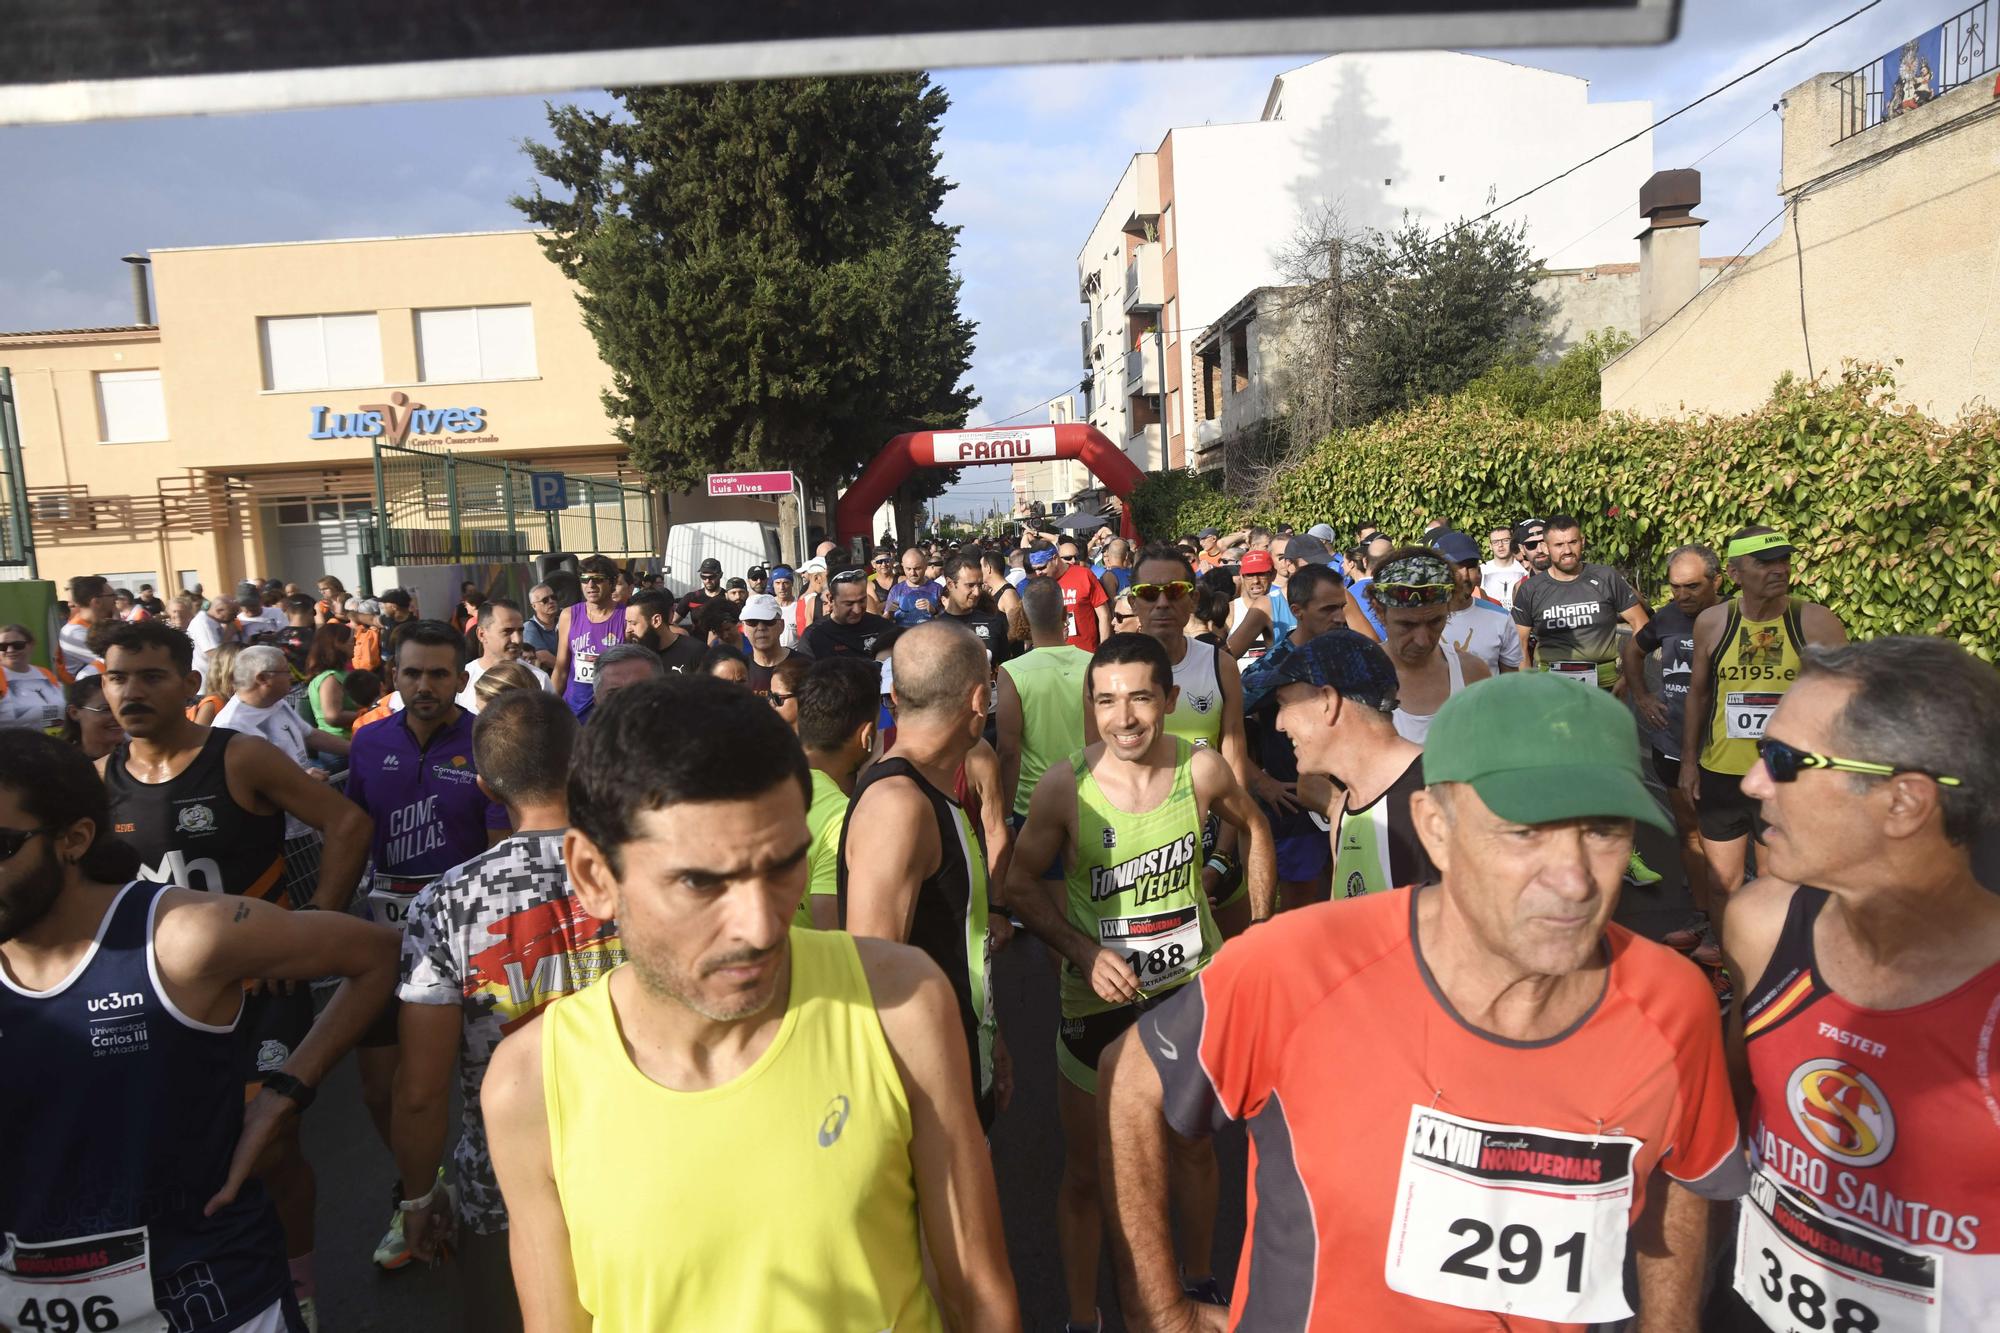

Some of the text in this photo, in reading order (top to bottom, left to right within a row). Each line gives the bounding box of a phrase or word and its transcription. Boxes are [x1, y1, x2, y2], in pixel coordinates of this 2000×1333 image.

[958, 439, 1031, 460] FAMU
[538, 477, 559, 505] P
[712, 484, 762, 493] Luis Vives
[1546, 614, 1593, 629] coym
[1090, 832, 1196, 901] FONDISTAS
[1134, 864, 1190, 907] YECLA
[1129, 917, 1182, 934] NONDUERMAS
[87, 992, 144, 1012] uc3m
[90, 1021, 147, 1036] Universidad
[91, 1029, 148, 1047] Carlos III
[1817, 1021, 1887, 1058] FASTER
[93, 1043, 149, 1057] de Madrid
[1415, 1116, 1602, 1182] XXVIII NONDUERMAS
[1836, 1171, 1980, 1251] SANTOS
[1440, 1217, 1587, 1293] 291
[1774, 1203, 1884, 1276] NONDUERMAS
[1759, 1247, 1880, 1333] 388
[17, 1295, 119, 1333] 496
